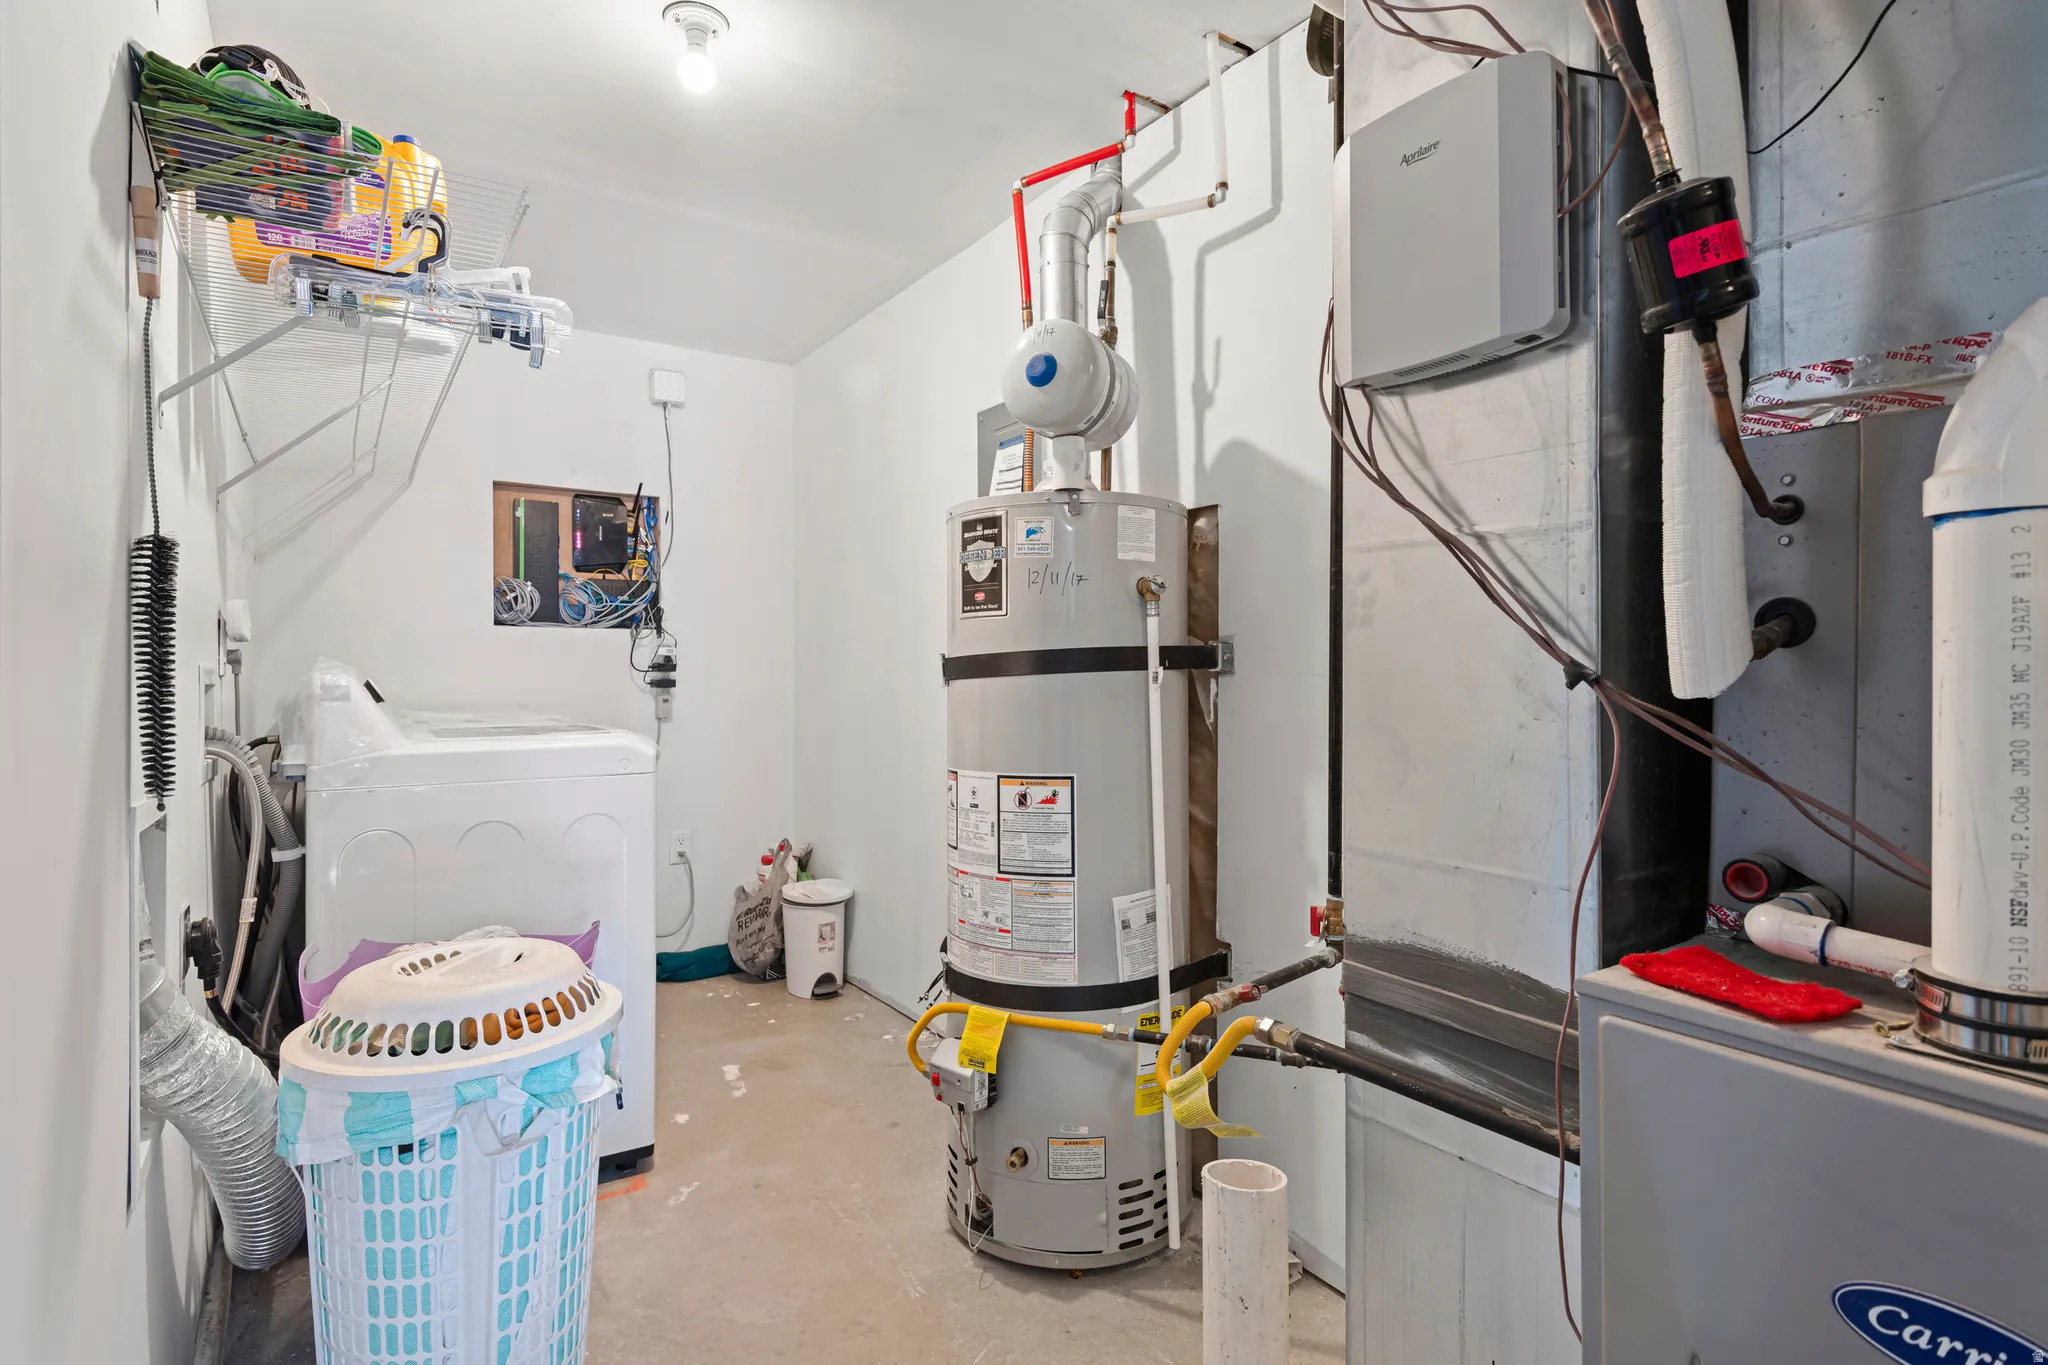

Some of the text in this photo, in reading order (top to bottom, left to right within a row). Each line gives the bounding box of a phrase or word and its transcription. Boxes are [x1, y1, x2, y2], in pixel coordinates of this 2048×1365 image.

[1400, 138, 1441, 167] Aprilaire
[2010, 524, 2032, 534] 2
[1028, 561, 1089, 596] 12/11/17
[2009, 551, 2032, 579] #13
[2011, 664, 2031, 683] MC
[2009, 692, 2031, 730] JM35
[2009, 739, 2031, 777] JM30
